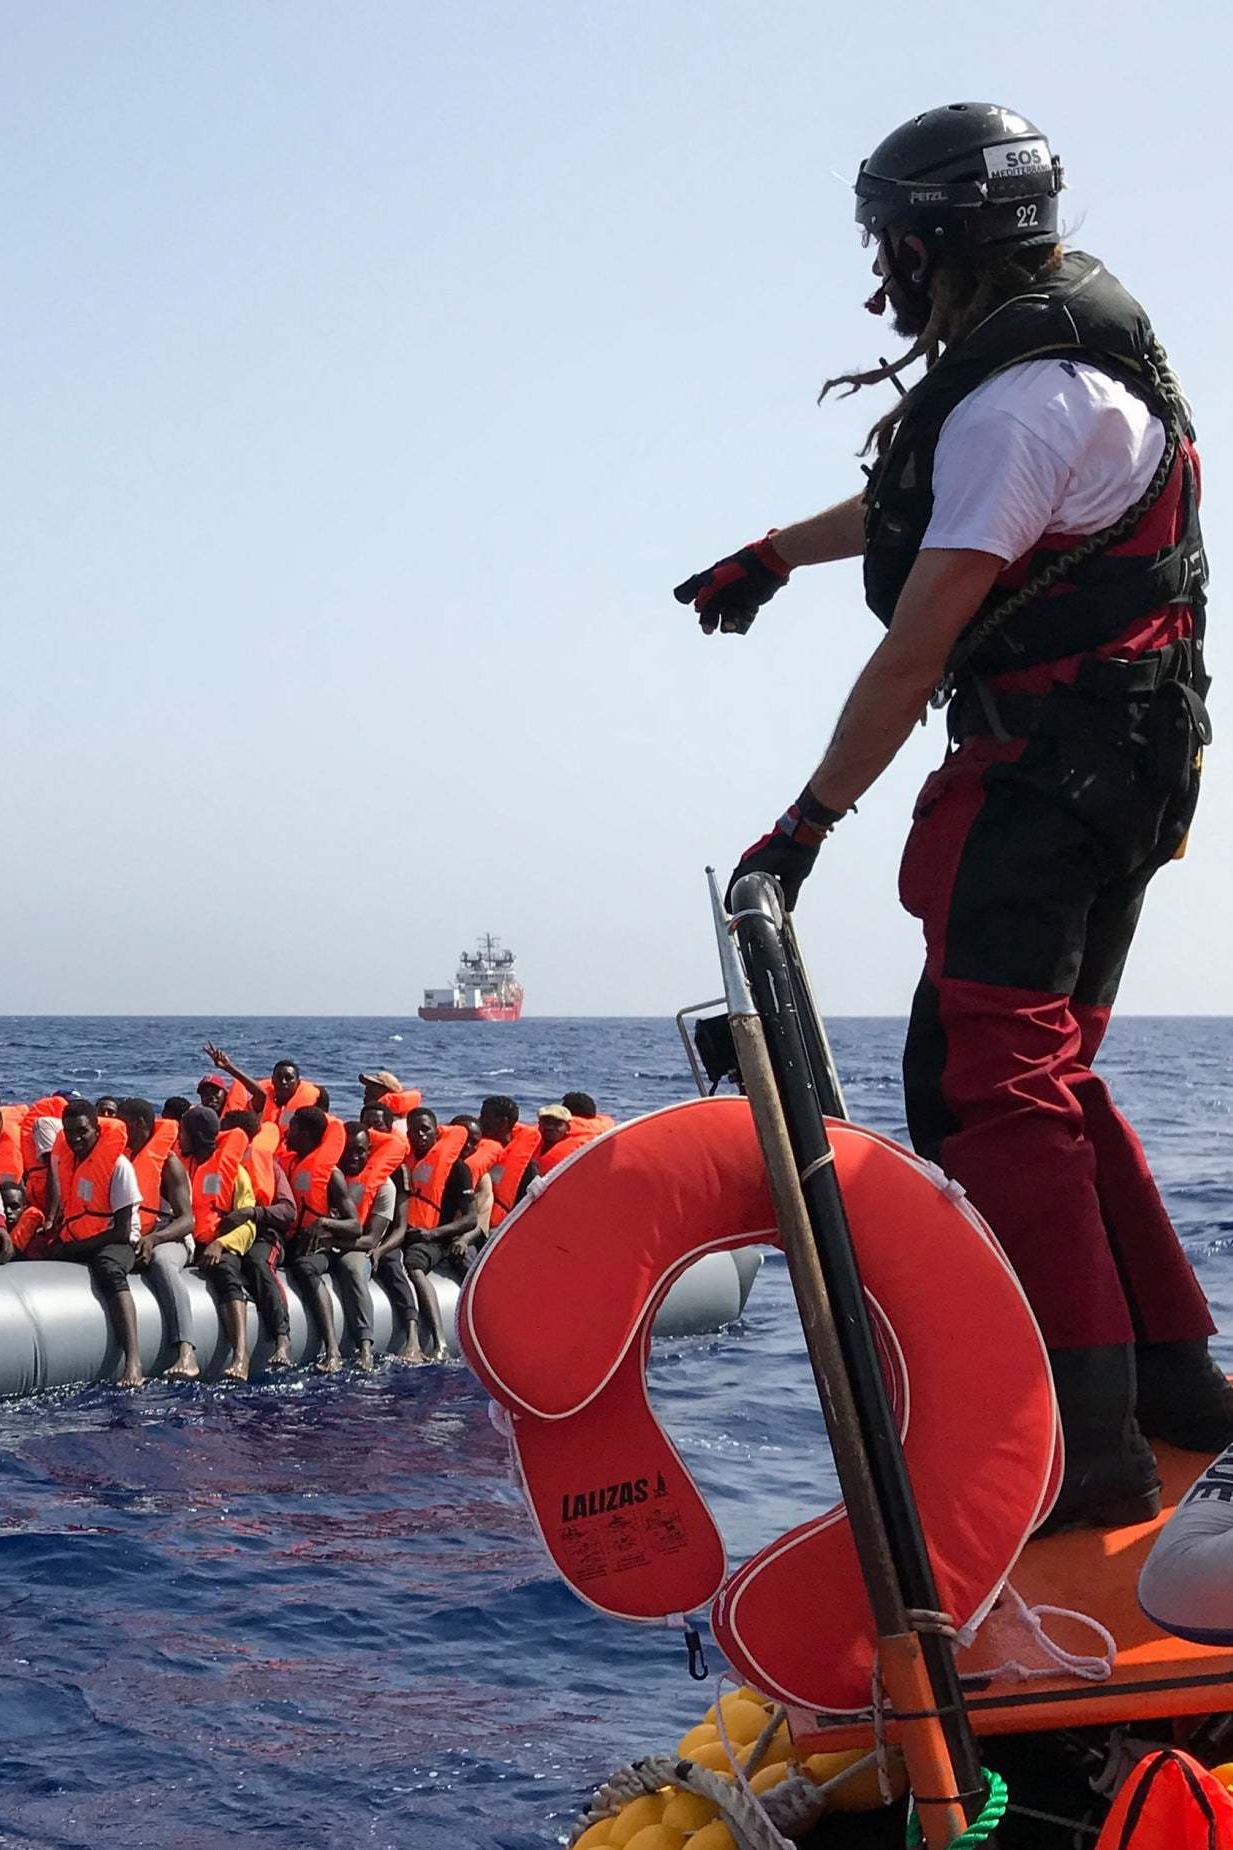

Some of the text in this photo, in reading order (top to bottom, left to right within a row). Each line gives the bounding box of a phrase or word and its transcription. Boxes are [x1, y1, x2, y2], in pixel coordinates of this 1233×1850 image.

[1005, 148, 1042, 168] SOS
[1016, 203, 1039, 228] 22
[561, 1478, 649, 1524] LALIZAS
